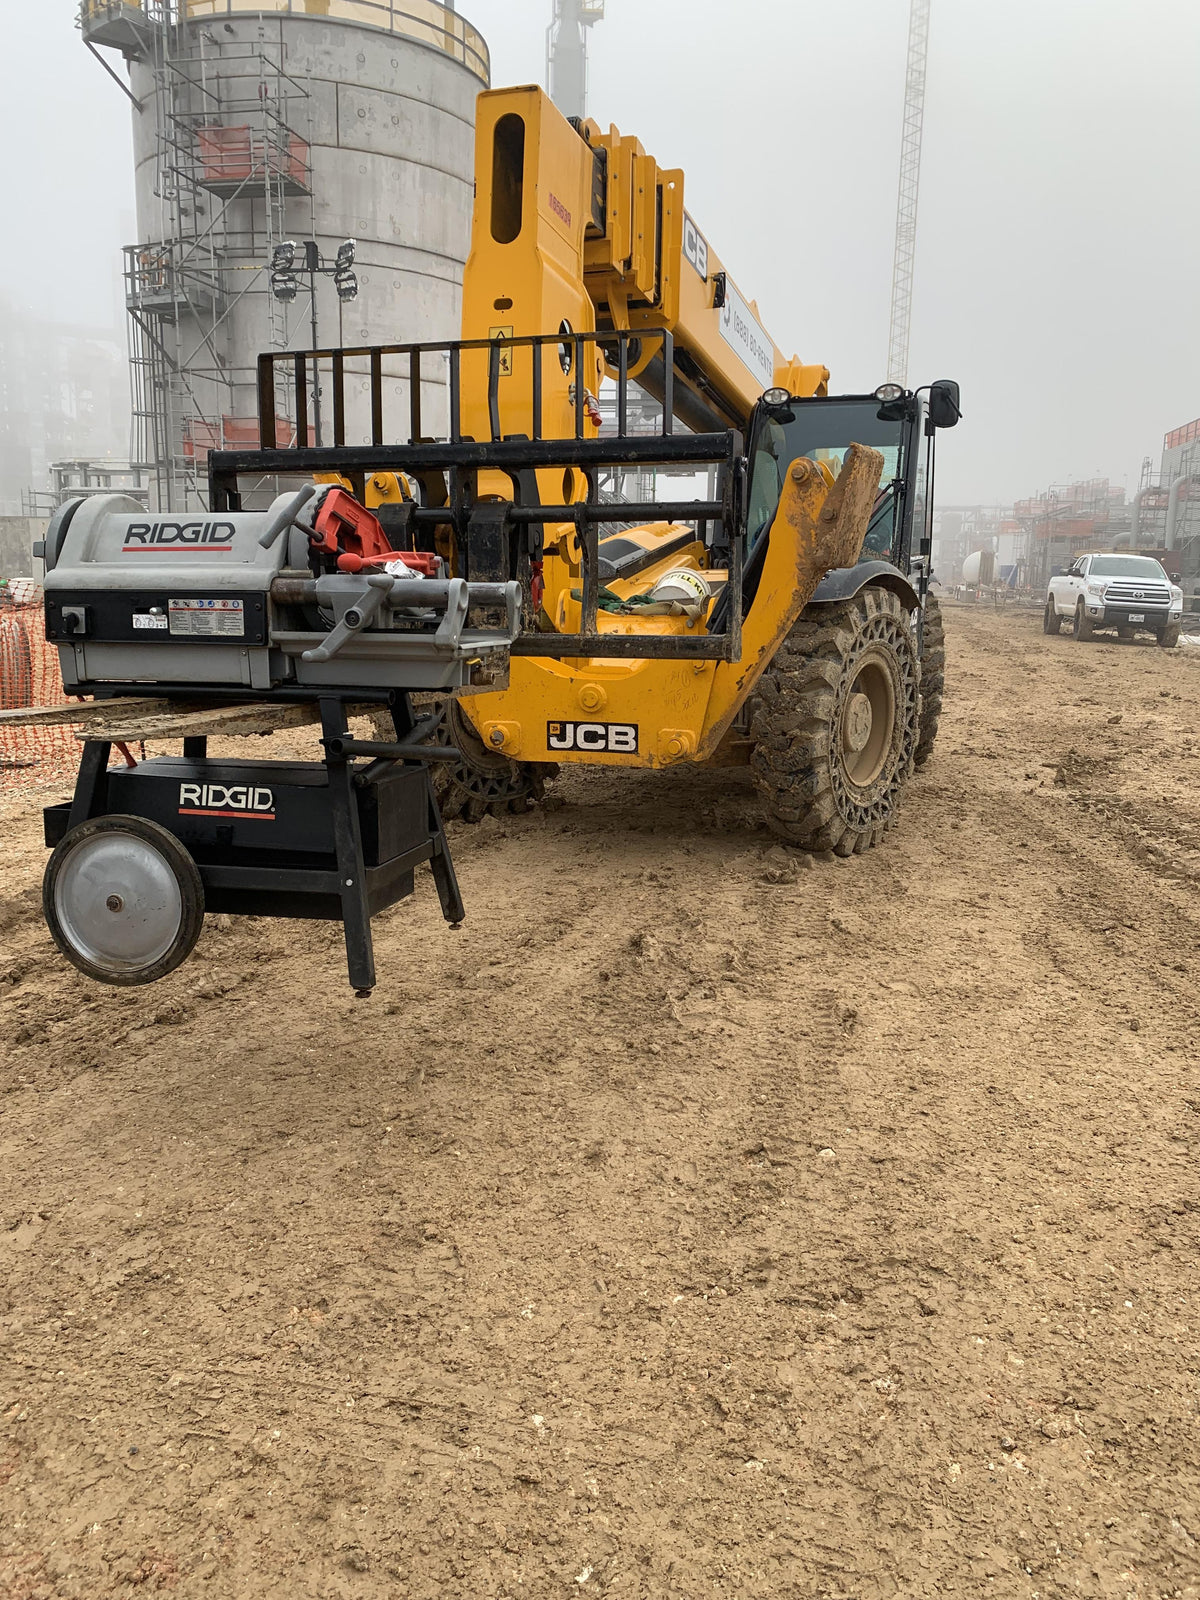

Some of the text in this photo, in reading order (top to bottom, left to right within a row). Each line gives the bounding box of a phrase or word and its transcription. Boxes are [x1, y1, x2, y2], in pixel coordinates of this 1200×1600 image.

[684, 216, 707, 281] CB
[124, 522, 236, 544] RIDGID
[549, 723, 637, 751] JCB
[179, 783, 273, 810] RIDGID
